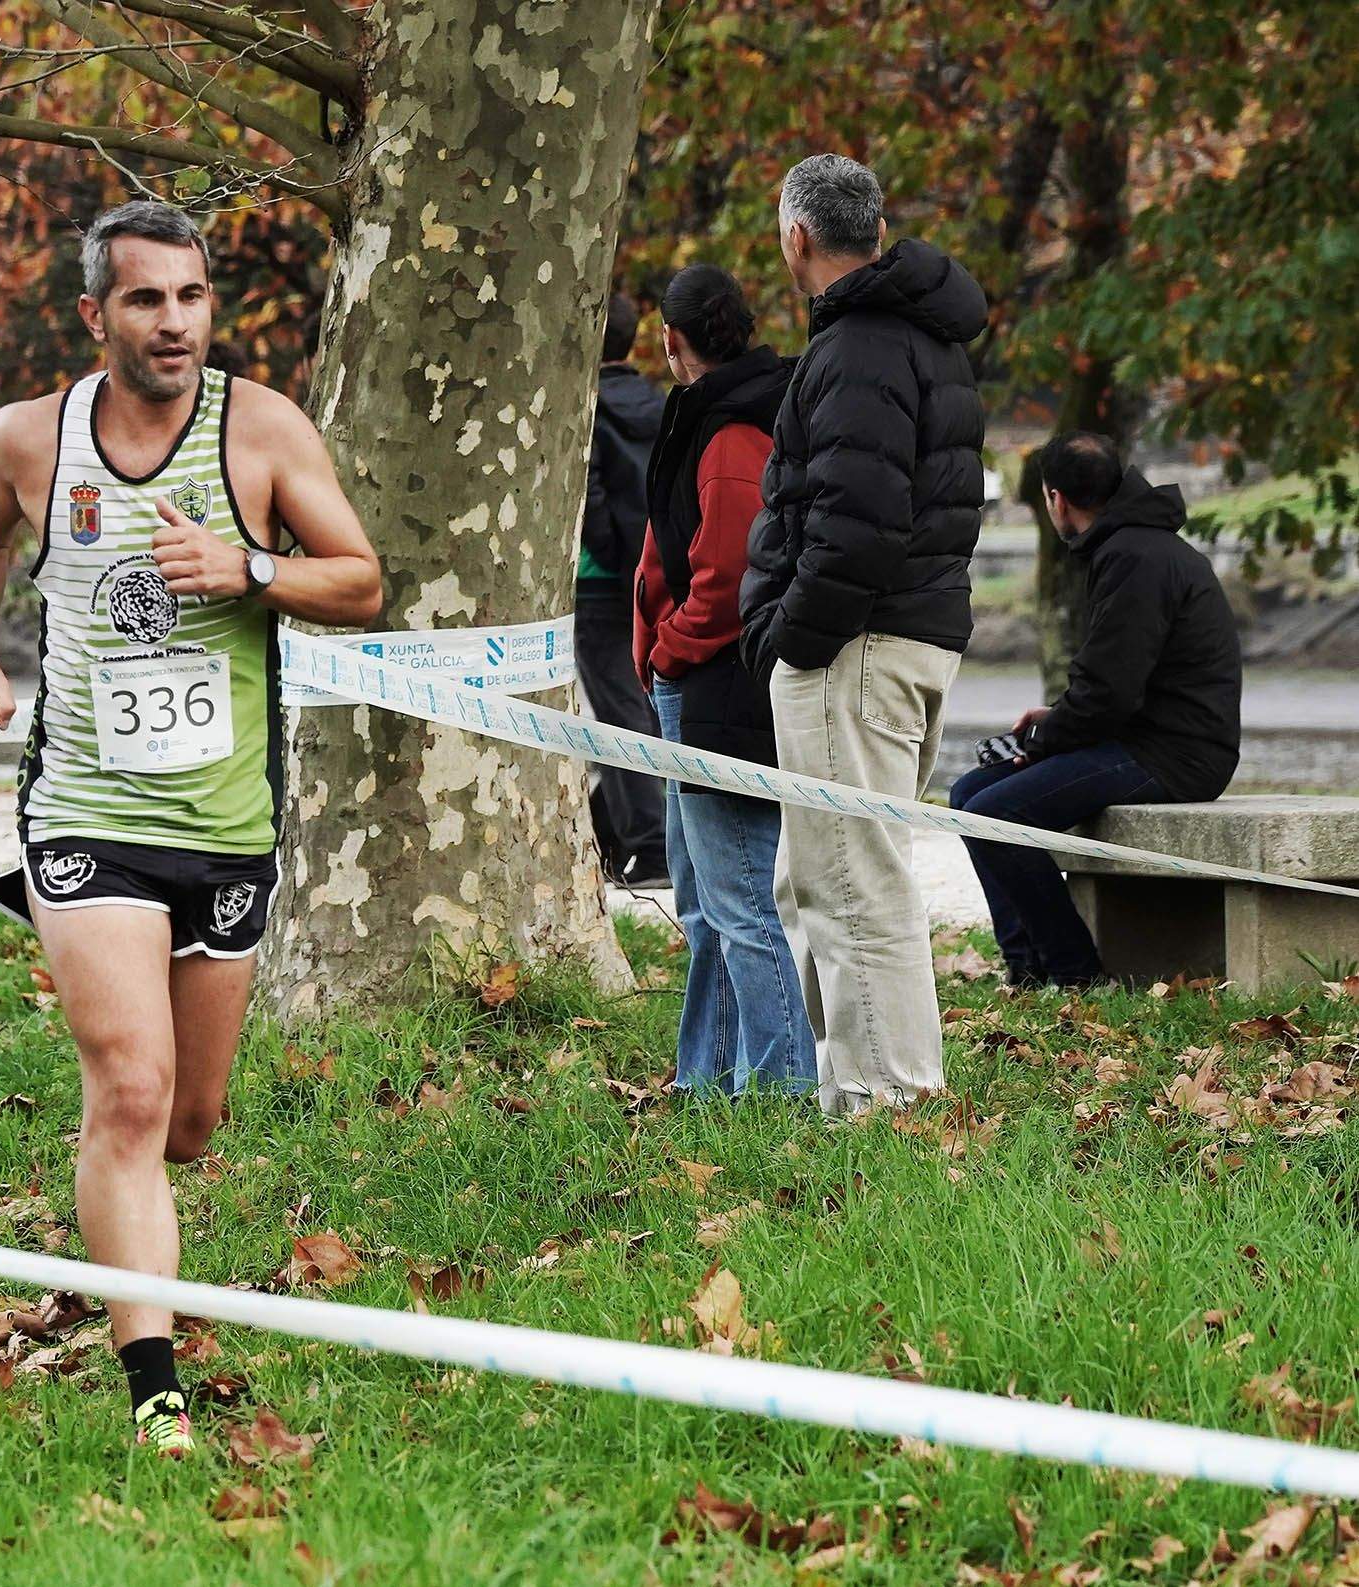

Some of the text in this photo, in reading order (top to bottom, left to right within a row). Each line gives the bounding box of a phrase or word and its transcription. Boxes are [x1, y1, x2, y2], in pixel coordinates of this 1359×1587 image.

[388, 643, 435, 656] XUNTA
[410, 656, 466, 669] GALICIA
[487, 675, 501, 686] DE
[111, 681, 215, 736] 336
